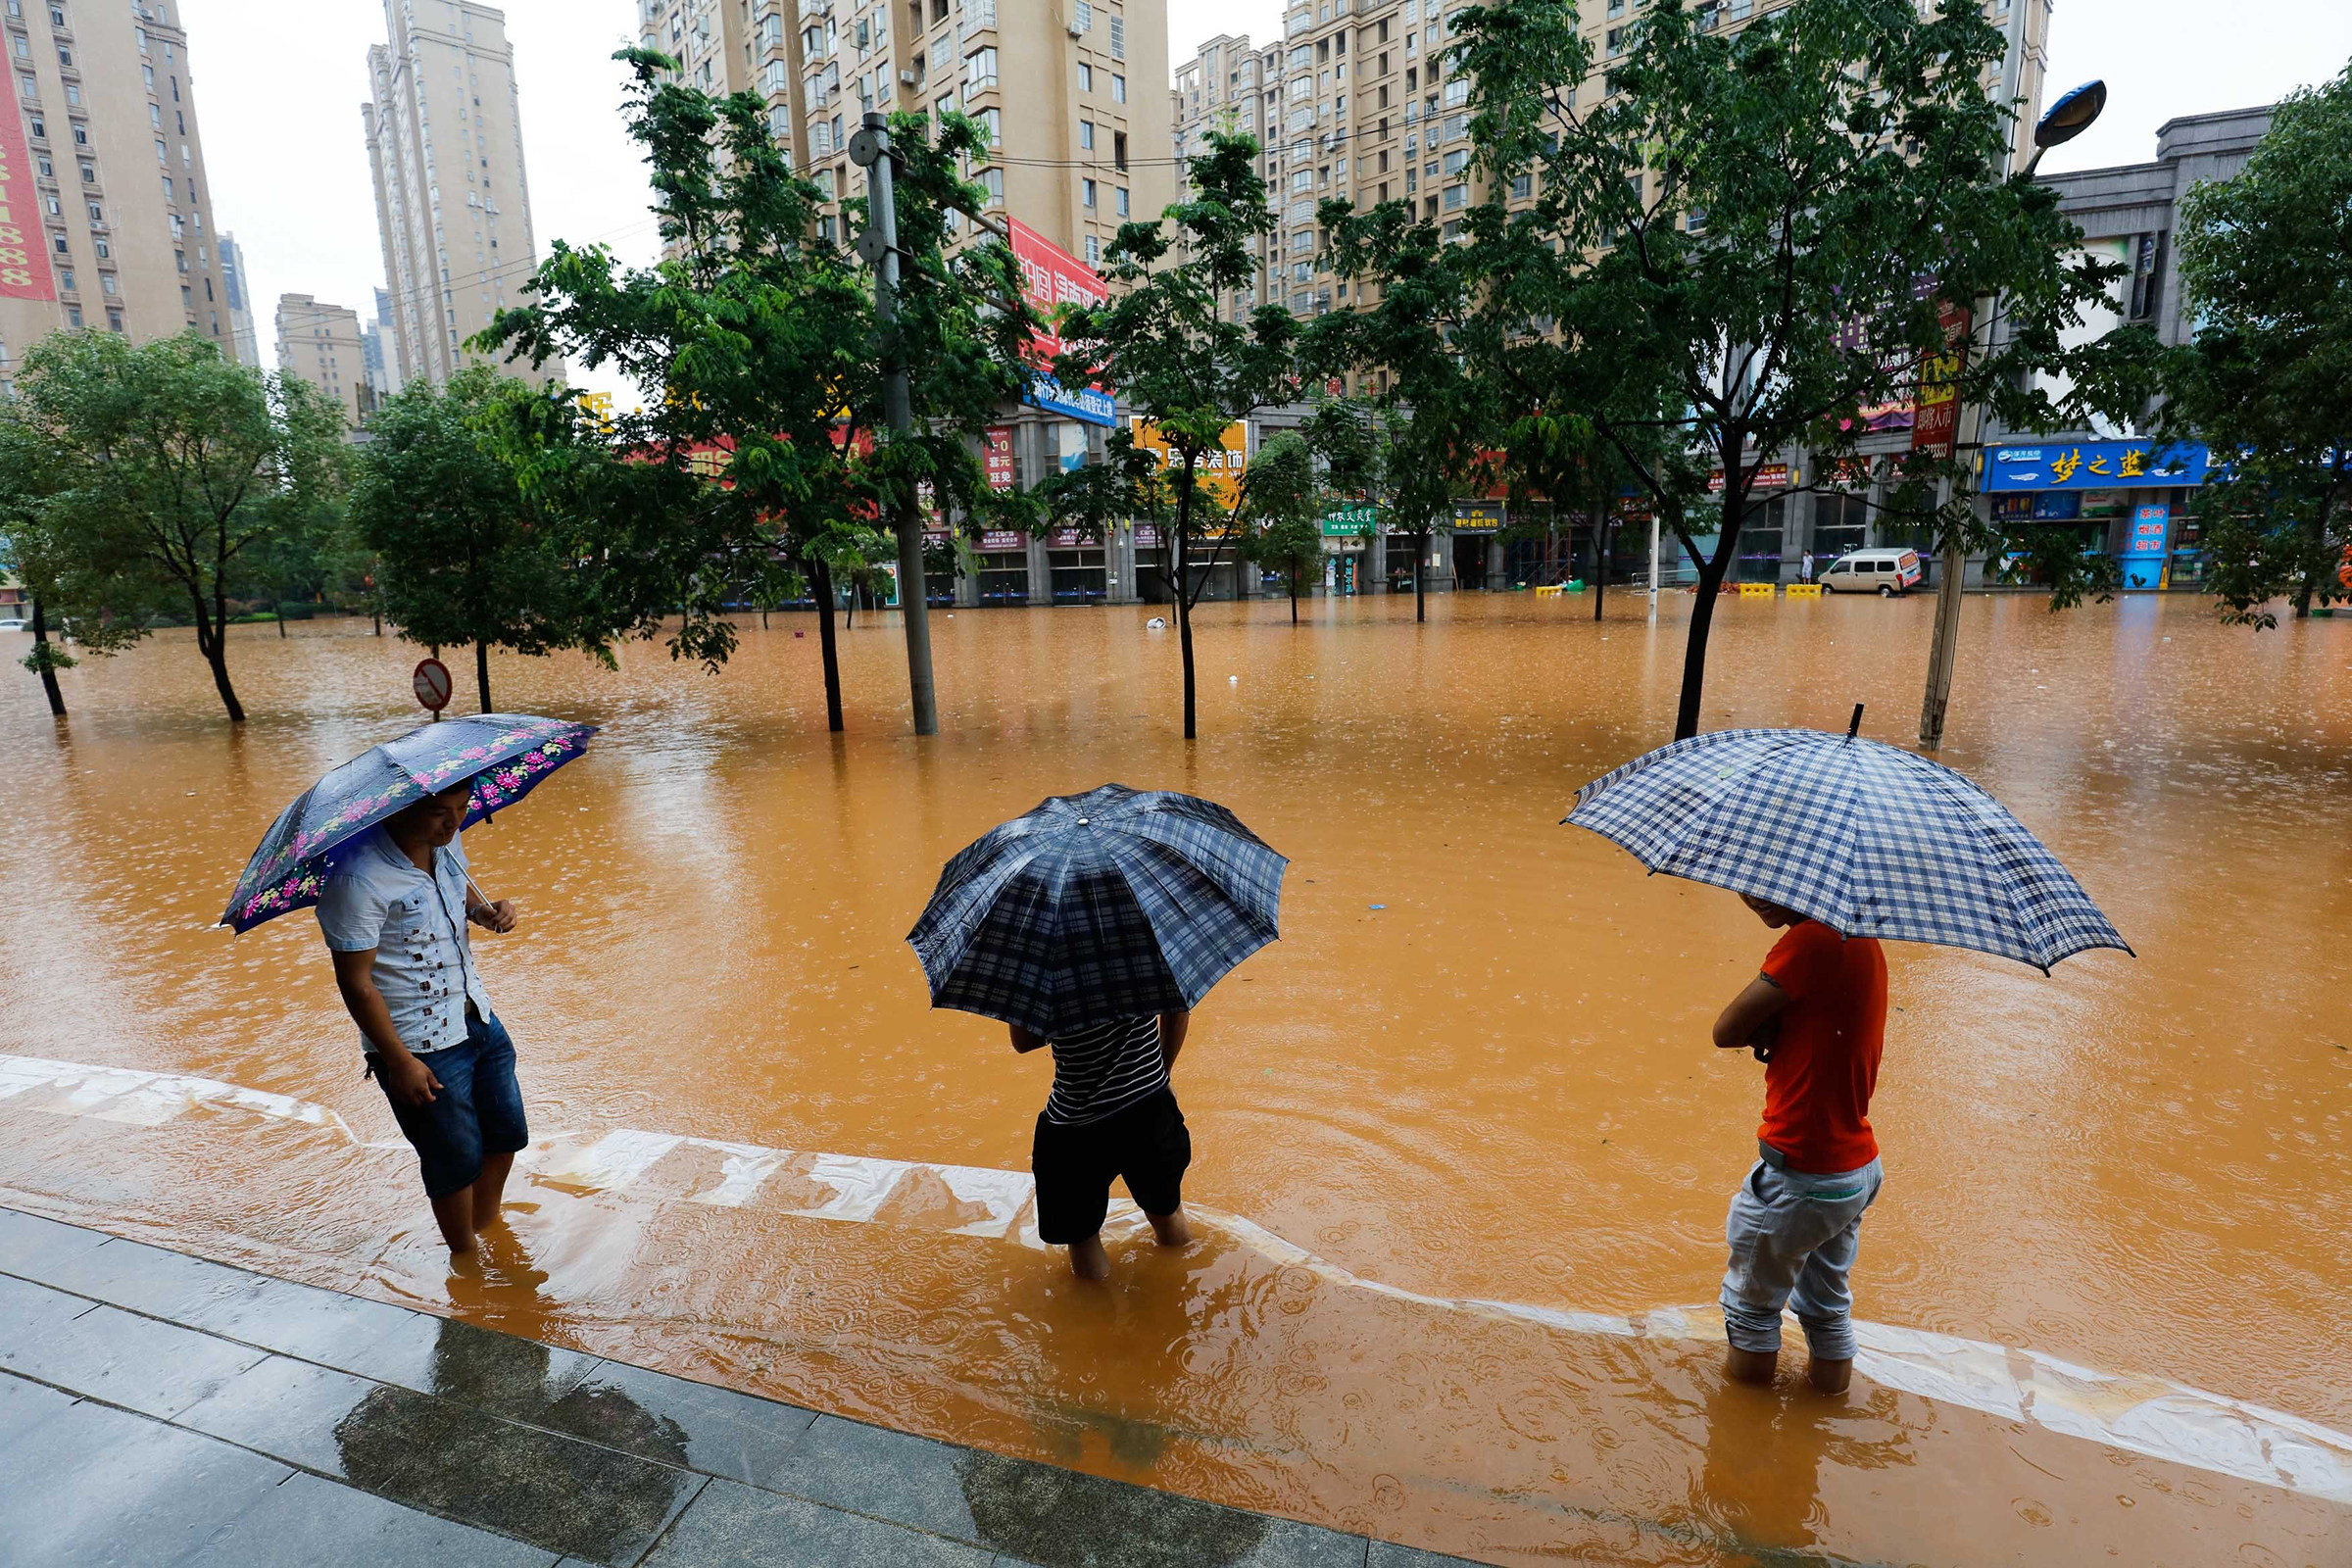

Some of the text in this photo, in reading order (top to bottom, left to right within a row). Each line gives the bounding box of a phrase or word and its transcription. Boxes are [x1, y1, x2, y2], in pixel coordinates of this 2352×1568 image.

[2049, 448, 2146, 485] 梦之蓝
[2139, 508, 2165, 518] 茶叶
[2137, 524, 2163, 535] 烟酒
[2135, 540, 2161, 551] 超市
